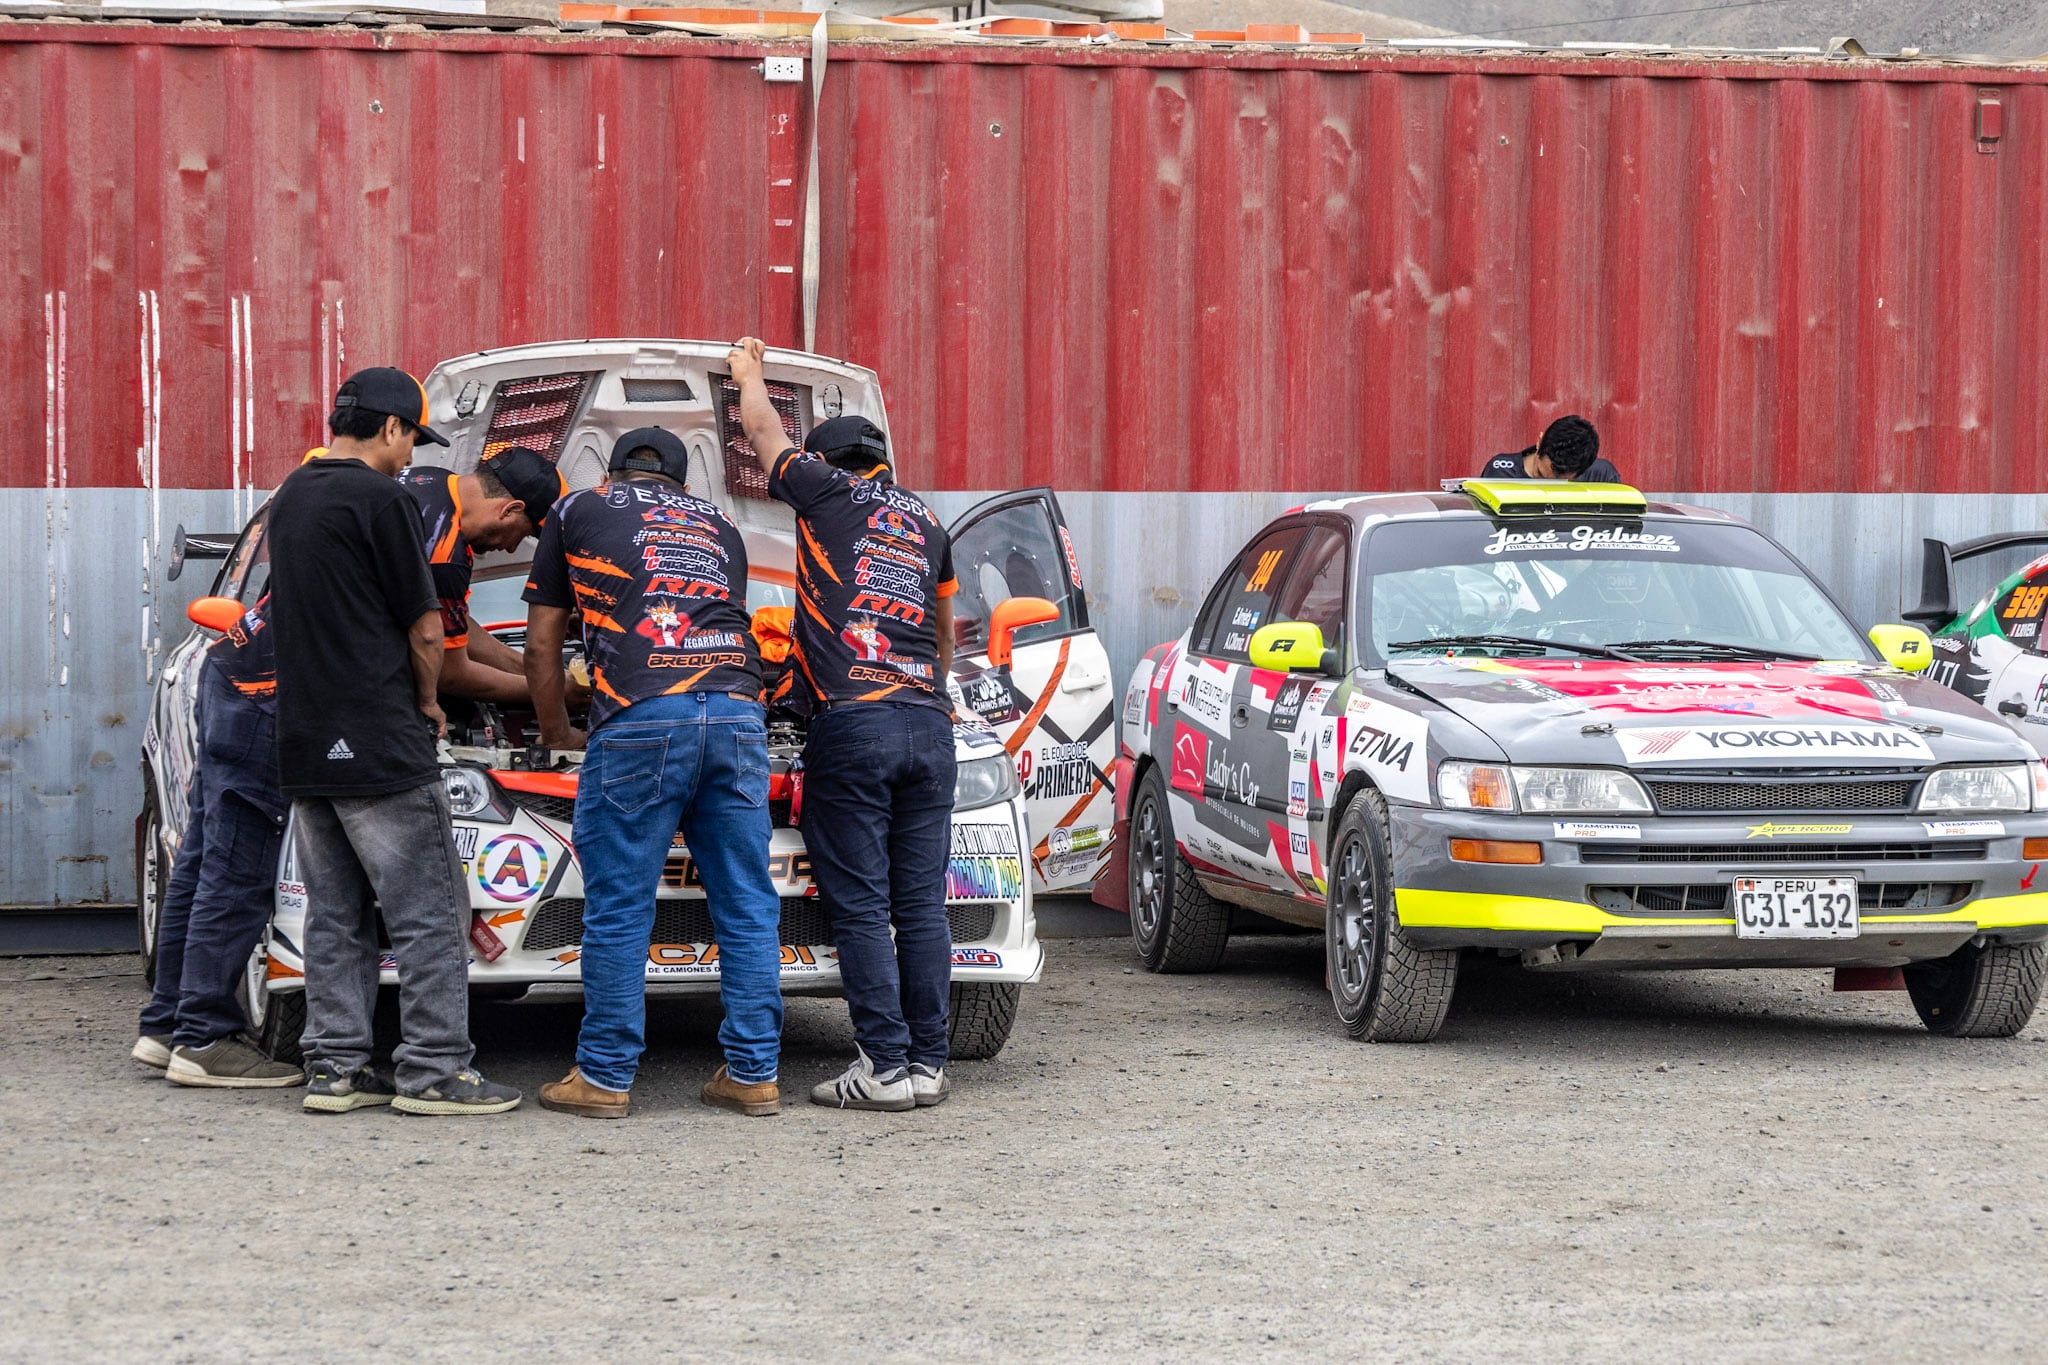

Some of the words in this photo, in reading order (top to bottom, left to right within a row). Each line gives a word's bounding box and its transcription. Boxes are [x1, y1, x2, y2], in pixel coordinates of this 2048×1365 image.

[1484, 527, 1559, 555] José
[1569, 525, 1676, 551] Gálvez
[854, 556, 921, 587] Repuestera
[1244, 550, 1283, 592] 244
[645, 577, 730, 601] RM
[855, 571, 925, 604] Copacabana
[848, 593, 926, 626] RM
[647, 652, 747, 669] AREQUIPA
[1041, 747, 1051, 761] EL
[1051, 742, 1078, 760] EQUIPO
[1078, 741, 1088, 758] DE
[1349, 725, 1414, 772] ETNA
[1695, 730, 1921, 748] YOKOHAMA
[327, 751, 354, 760] adidas
[1035, 760, 1093, 801] PRIMERA
[1239, 761, 1260, 807] Car
[1774, 880, 1816, 893] PERU
[1741, 893, 1853, 929] C3I-132
[663, 966, 712, 974] CAMIONES
